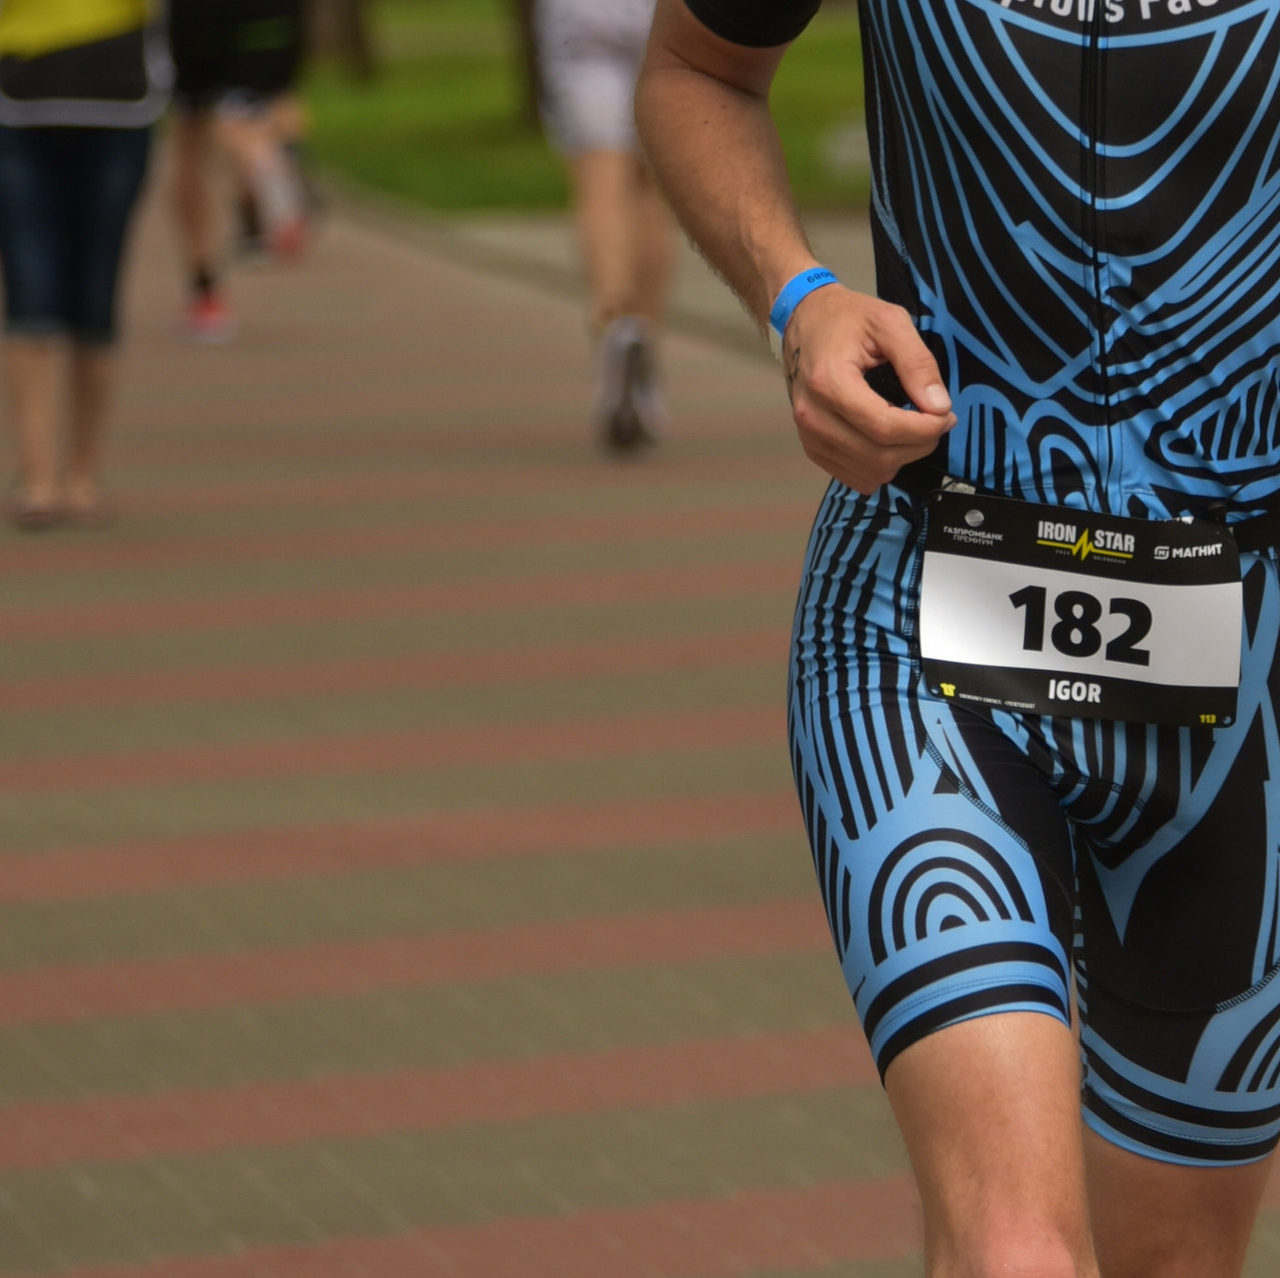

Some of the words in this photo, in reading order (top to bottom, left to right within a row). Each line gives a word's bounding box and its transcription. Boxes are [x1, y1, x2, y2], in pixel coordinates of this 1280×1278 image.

[943, 526, 1004, 542] ГАЗПРОМБАНК
[952, 534, 994, 546] ПРЕМИУМ
[1037, 520, 1077, 543] IRON
[1094, 529, 1136, 553] STAR
[1172, 543, 1223, 559] МАГНИТ
[1008, 584, 1153, 667] 182
[1048, 679, 1101, 704] IGOR
